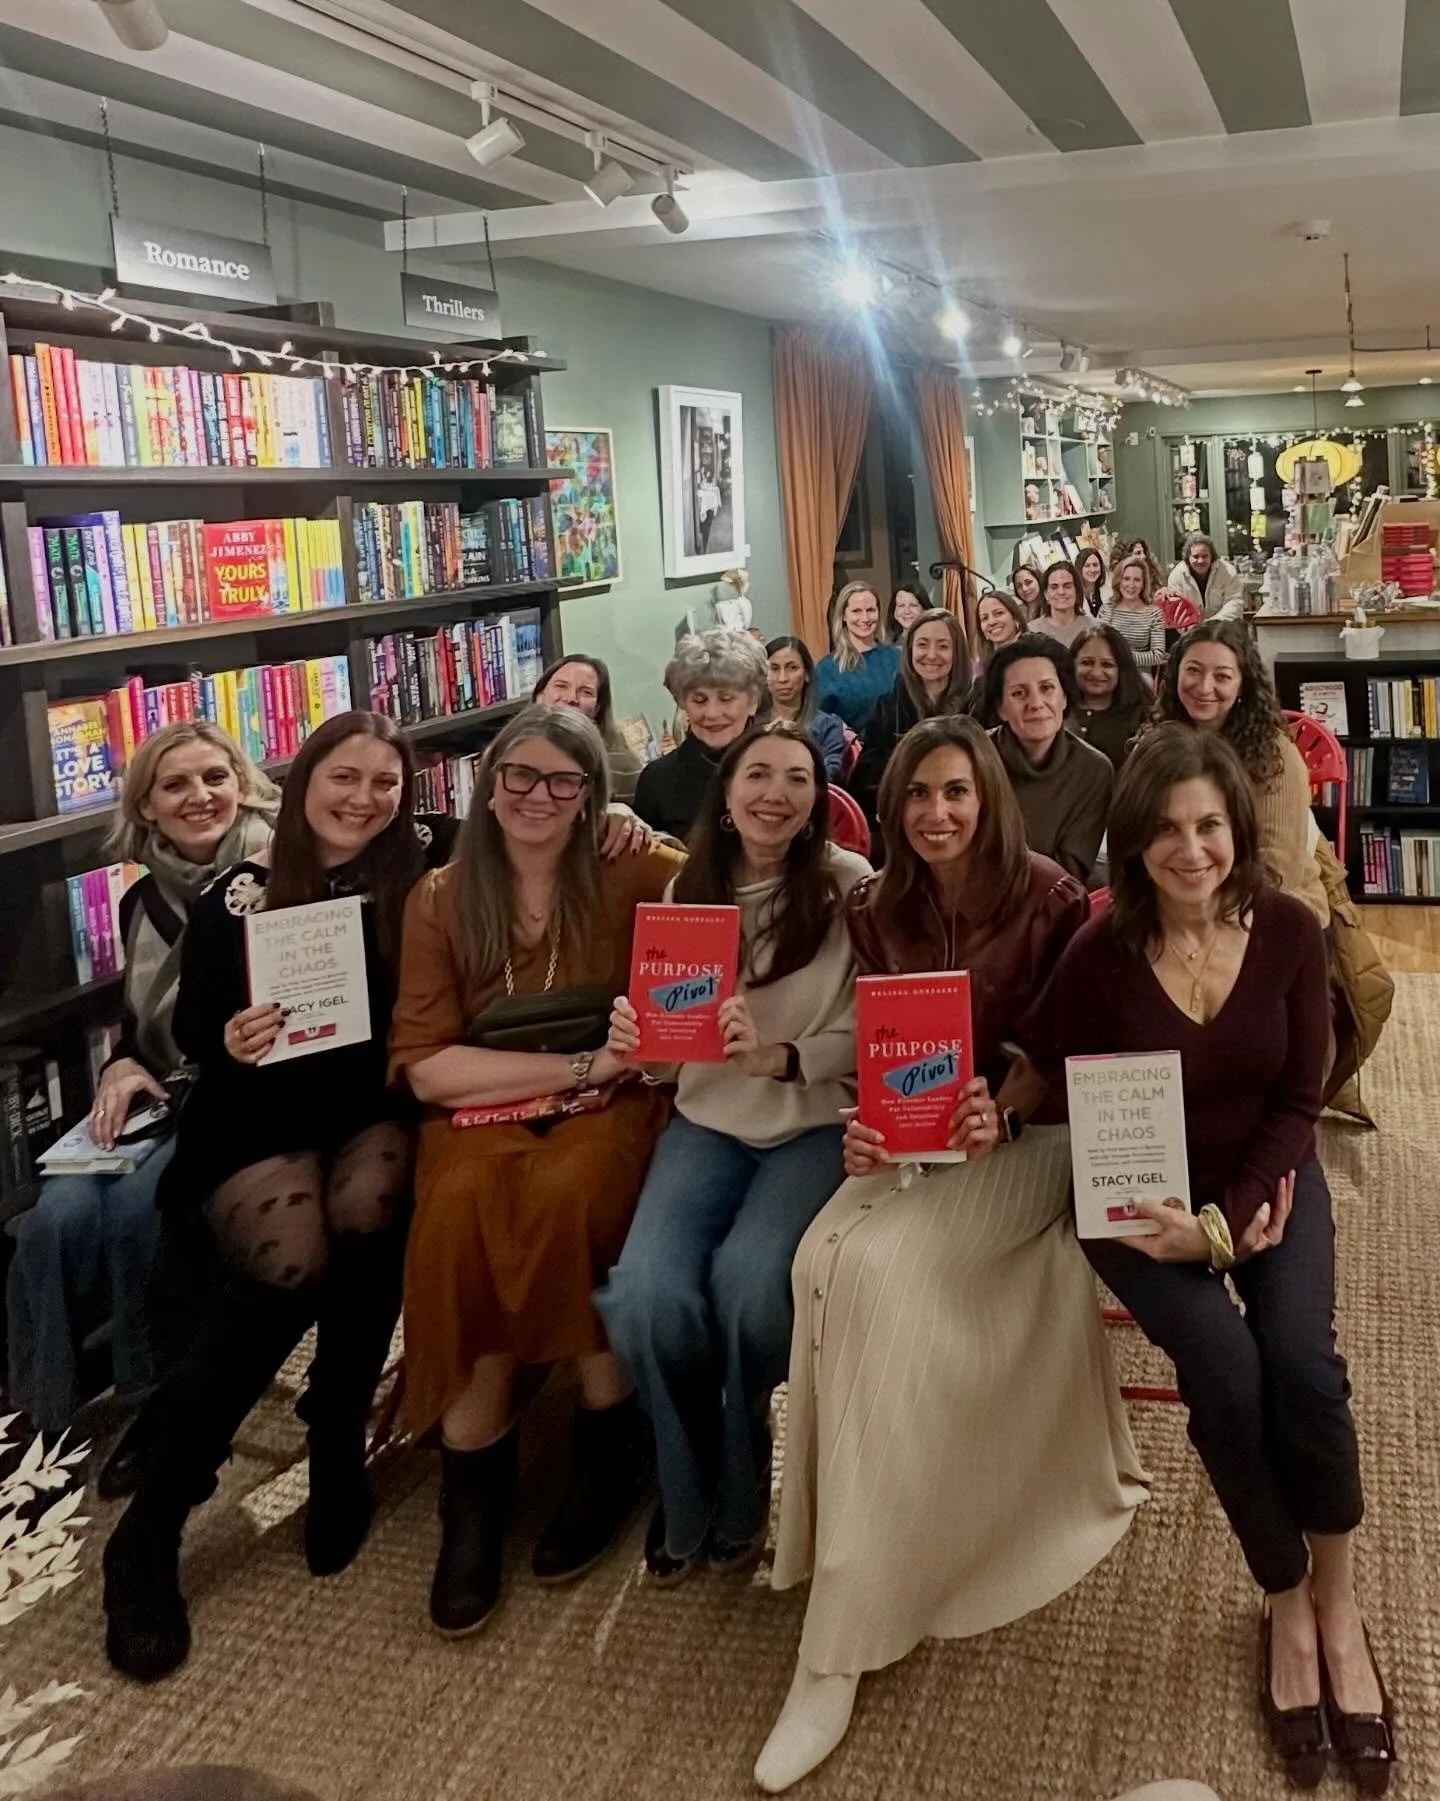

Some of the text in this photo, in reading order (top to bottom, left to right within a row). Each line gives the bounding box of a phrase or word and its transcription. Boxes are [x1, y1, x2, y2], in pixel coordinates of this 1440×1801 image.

[144, 240, 250, 281] Romance
[422, 294, 485, 321] Thrillers
[223, 531, 256, 544] ABBY
[210, 544, 267, 558] JIMENEZ
[214, 563, 267, 582] YOURS
[219, 585, 266, 605] TRULY
[89, 743, 100, 754] A
[53, 755, 105, 780] LOVE
[55, 771, 111, 798] STORY
[255, 906, 353, 935] EMBRACING
[264, 923, 347, 950] THE CALM
[280, 942, 334, 963] IN THE
[646, 946, 668, 961] the
[279, 957, 338, 979] CHAOS
[639, 962, 724, 977] PURPOSE
[289, 995, 349, 1014] ACY IGEL
[875, 1025, 898, 1042] the
[869, 1039, 963, 1058] PURPOSE
[1072, 1067, 1171, 1086] EMBRACING
[1082, 1087, 1165, 1104] THE CALM
[1098, 1107, 1151, 1123] IN THE
[1097, 1126, 1155, 1142] CHAOS
[1091, 1172, 1168, 1187] STACY IGEL
